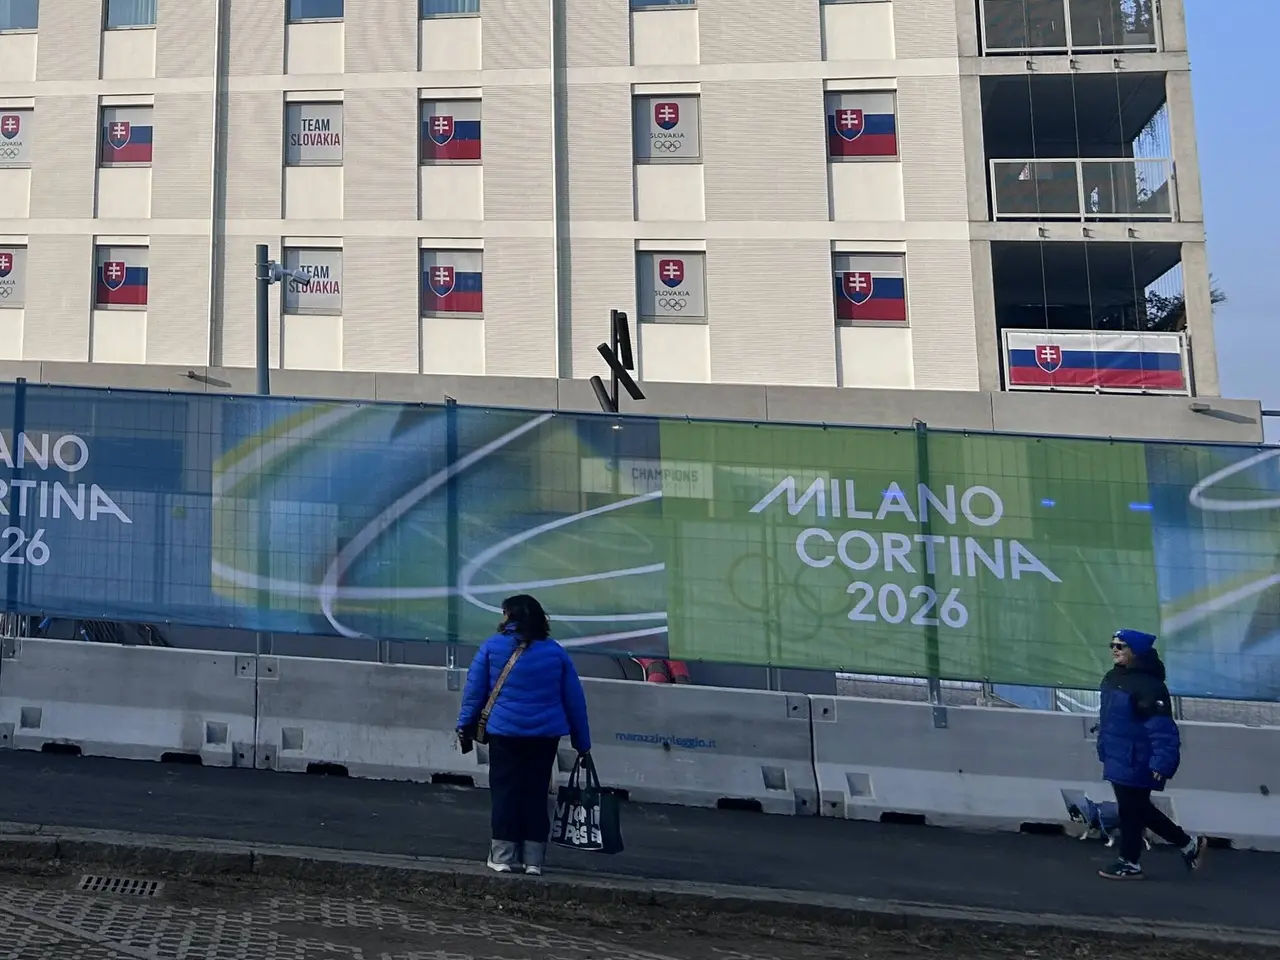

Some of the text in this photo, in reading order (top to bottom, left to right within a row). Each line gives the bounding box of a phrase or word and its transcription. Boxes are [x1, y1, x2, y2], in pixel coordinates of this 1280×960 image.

[290, 132, 341, 146] SLOVAKIA
[301, 118, 330, 131] TEAM
[631, 467, 699, 482] CHAMPIONS
[748, 475, 1004, 526] MILANO
[795, 527, 1063, 583] CORTINA
[846, 581, 969, 628] 2026
